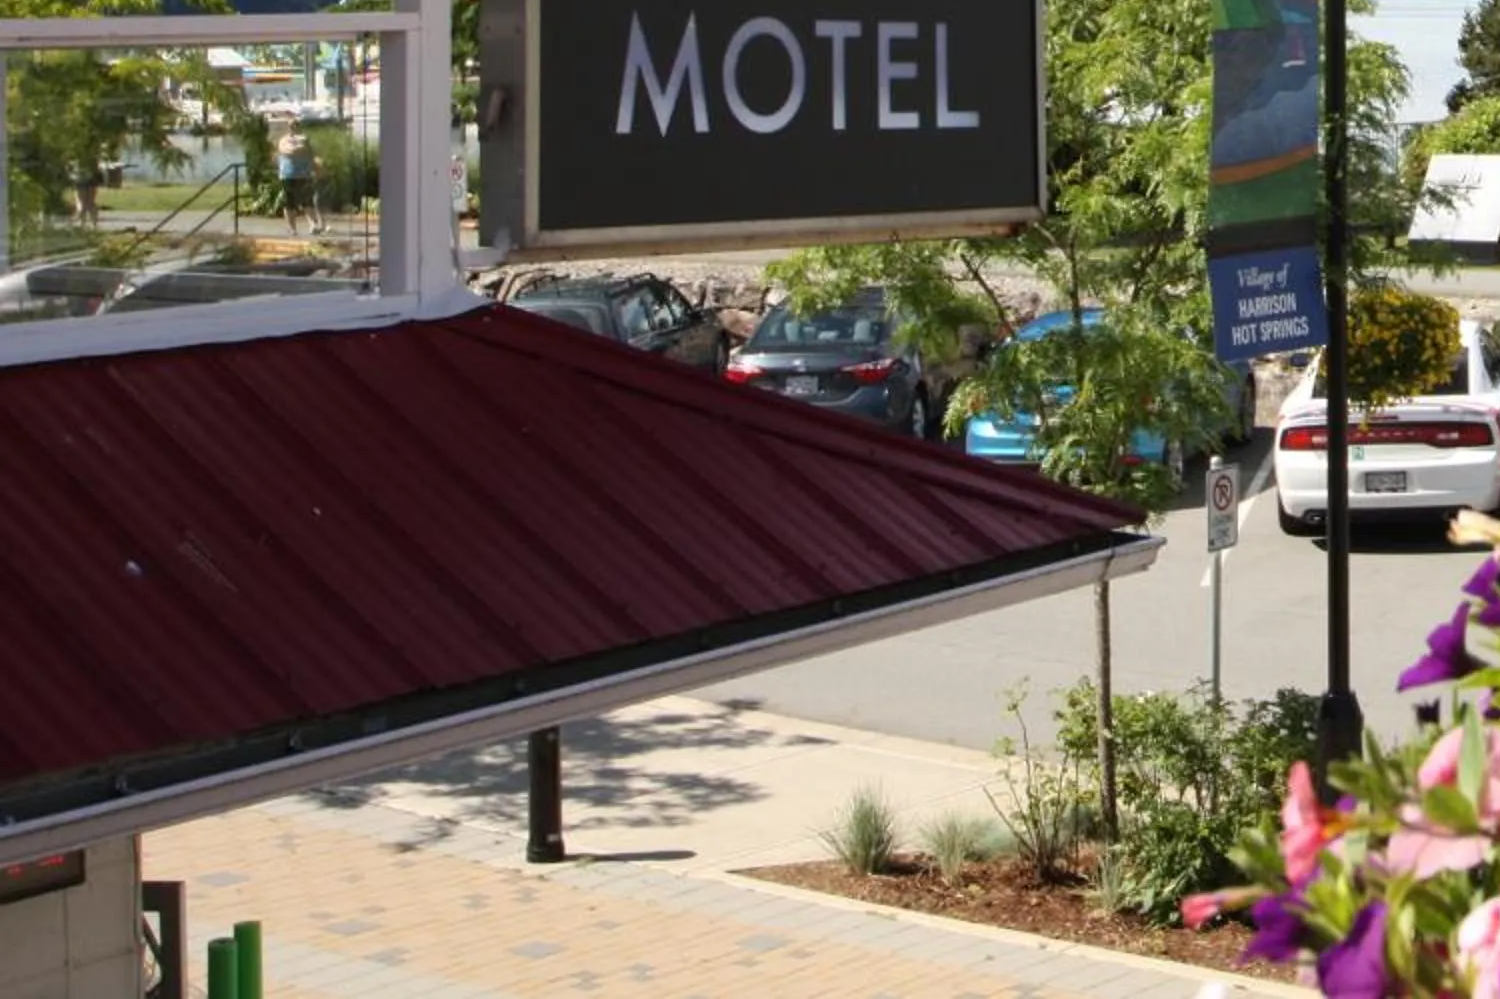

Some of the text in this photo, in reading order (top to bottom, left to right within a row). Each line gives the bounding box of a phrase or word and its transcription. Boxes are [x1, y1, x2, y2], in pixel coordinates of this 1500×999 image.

[615, 10, 980, 137] MOTEL
[1237, 263, 1291, 290] Village of
[1238, 292, 1297, 318] HARRISON
[1231, 315, 1309, 346] HOT SPRINGS
